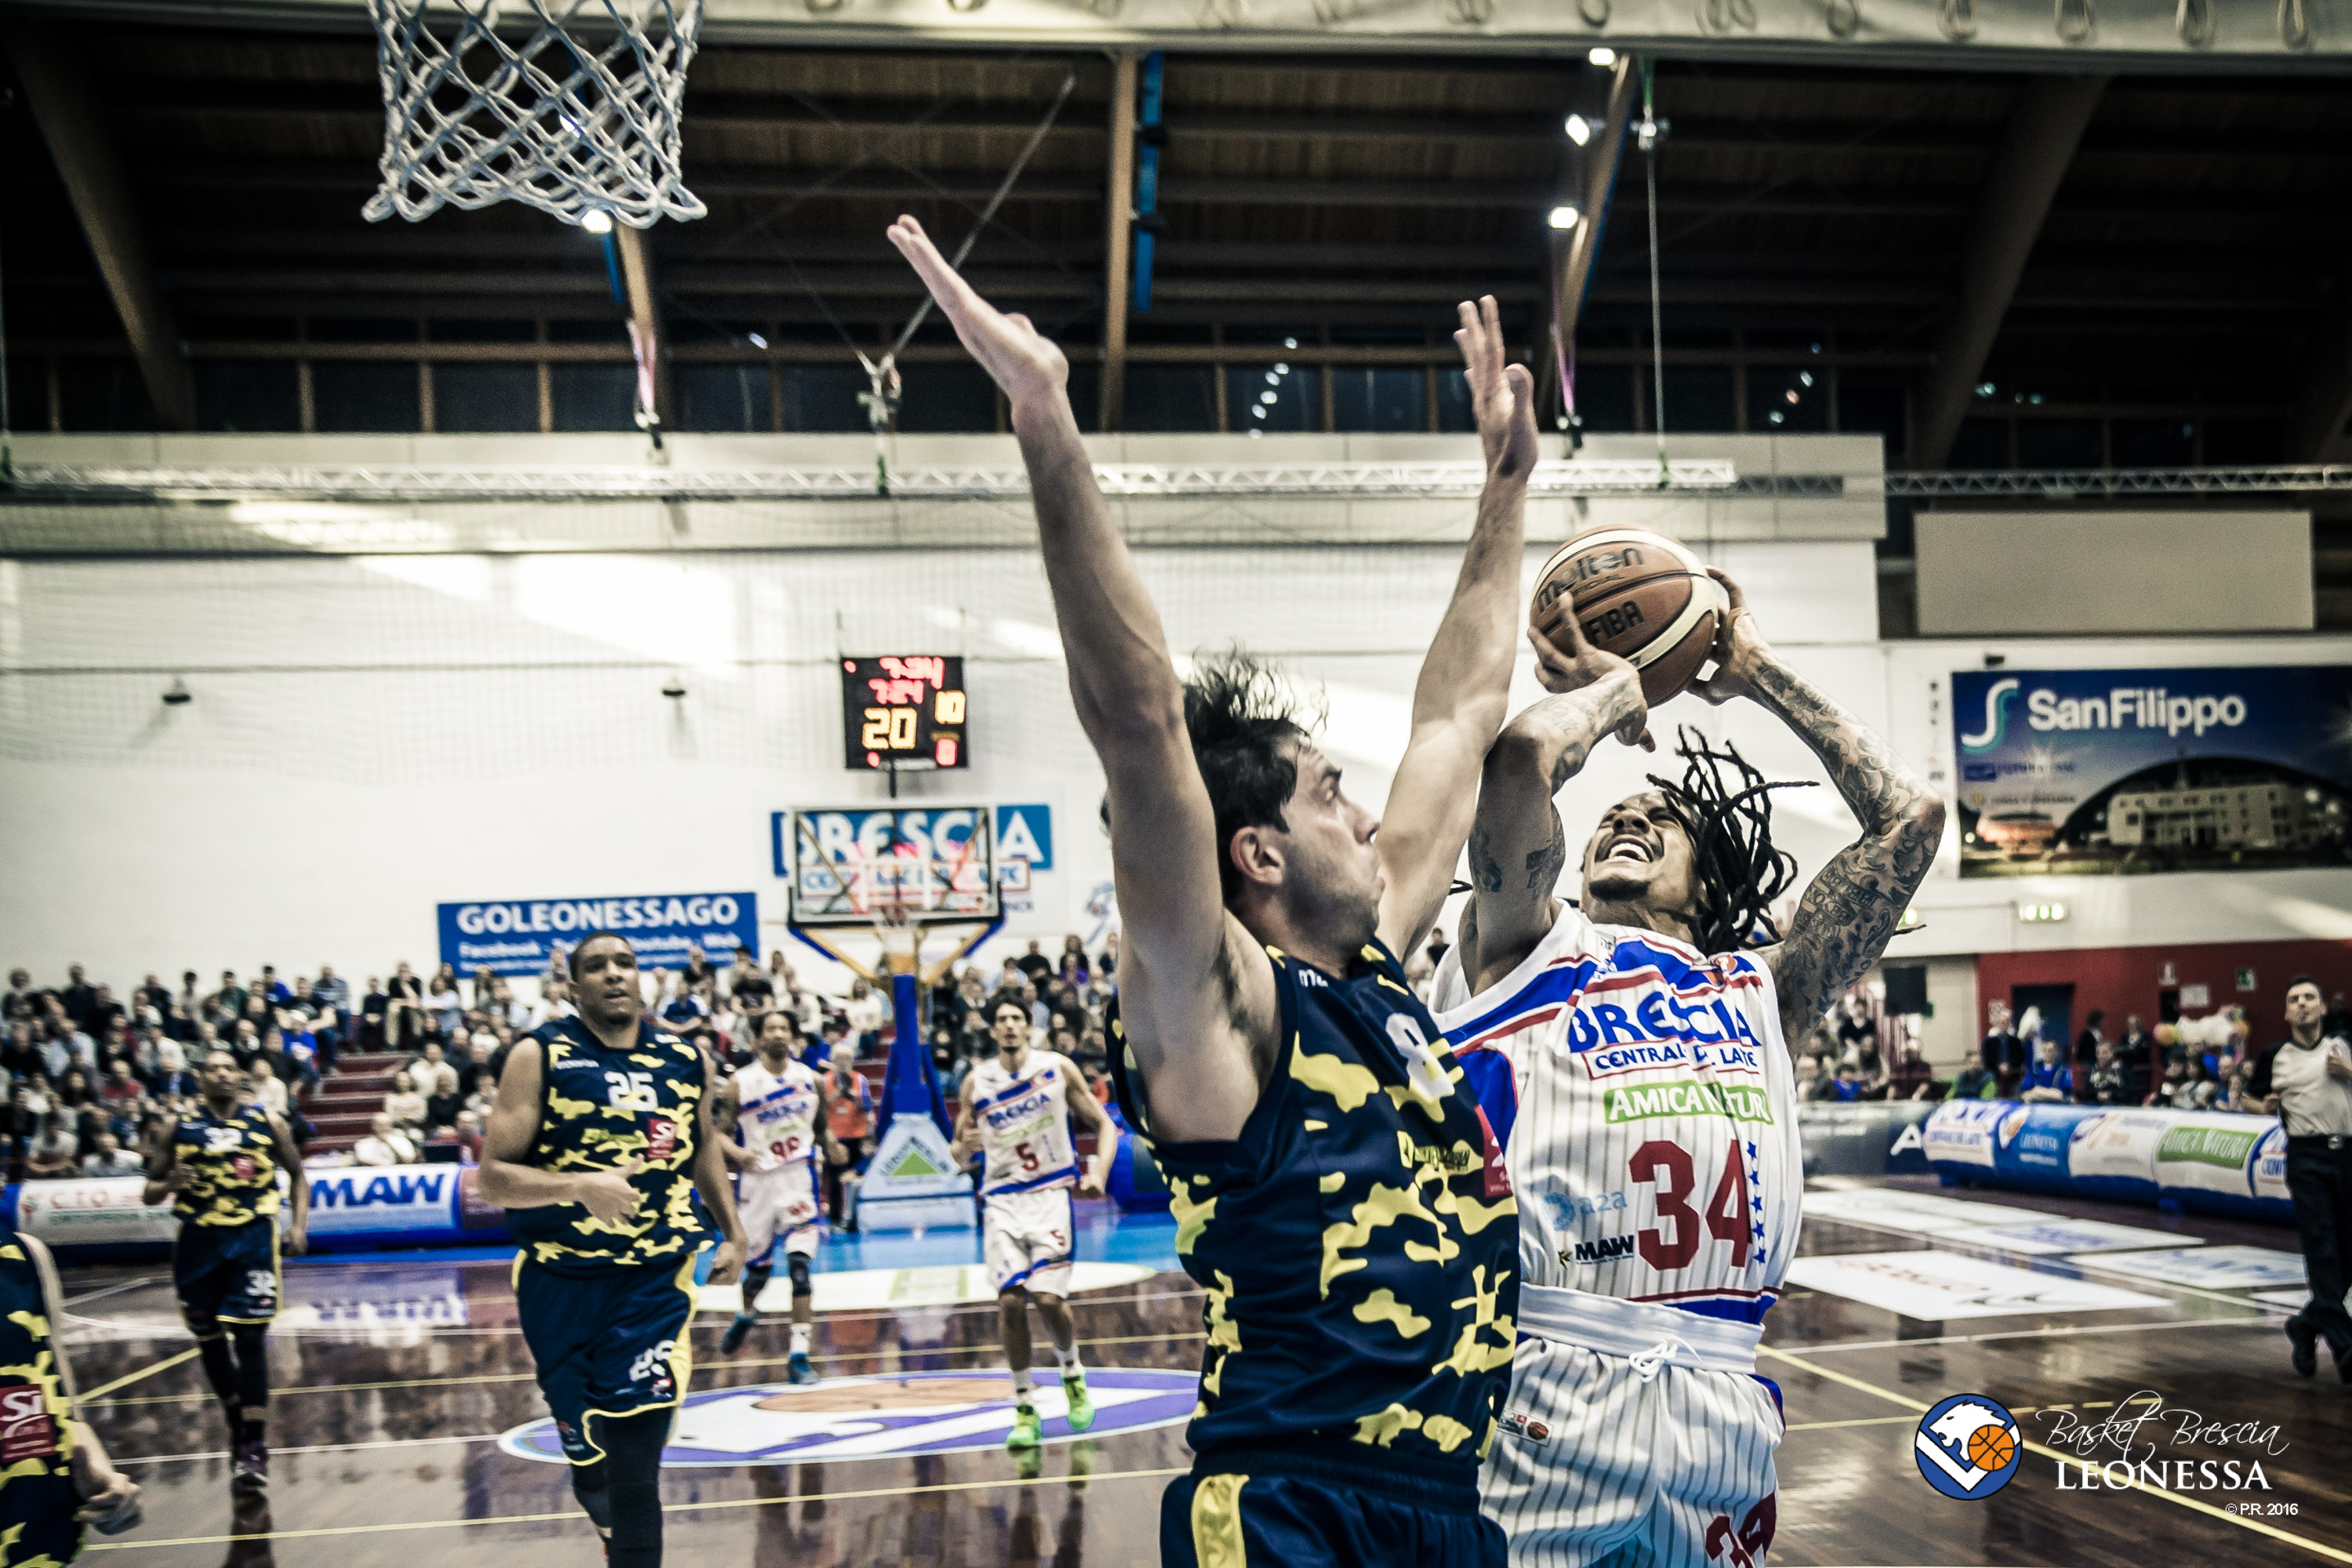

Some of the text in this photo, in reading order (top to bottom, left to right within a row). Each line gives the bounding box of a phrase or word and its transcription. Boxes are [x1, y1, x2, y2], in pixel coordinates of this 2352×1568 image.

[1584, 601, 1645, 645] FIBA
[862, 707, 917, 750] 20
[2027, 687, 2248, 739] SanFilippo
[456, 896, 739, 935] GOLEONESSAGO
[1595, 1044, 1687, 1069] CENTRAL
[604, 1071, 659, 1112] 25
[1016, 1142, 1040, 1171] 5
[310, 1174, 445, 1208] MAW
[1629, 1140, 1755, 1271] 34
[1574, 1234, 1635, 1261] MAW
